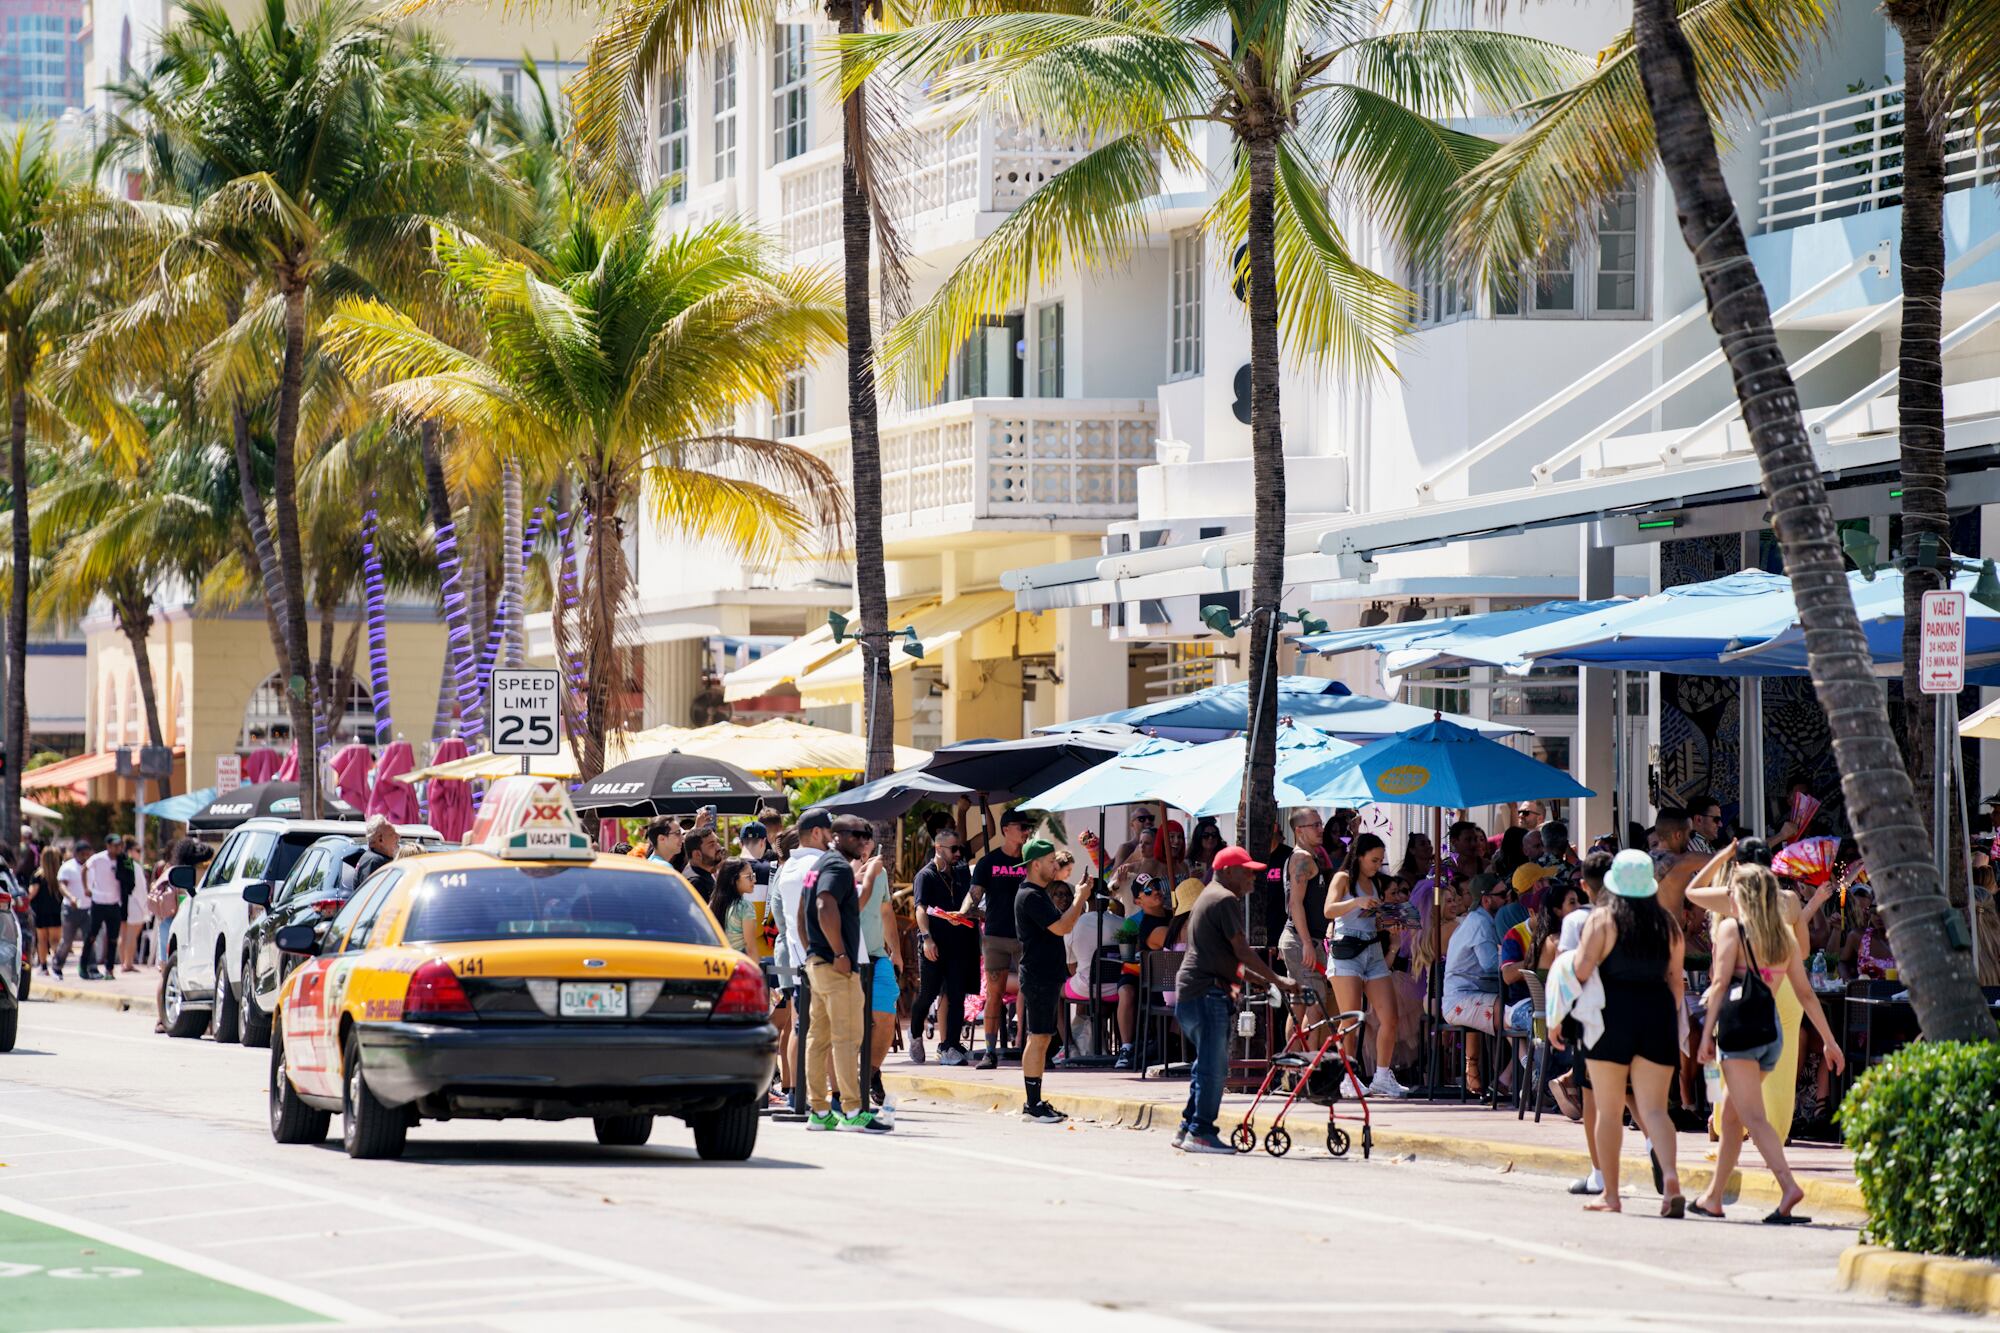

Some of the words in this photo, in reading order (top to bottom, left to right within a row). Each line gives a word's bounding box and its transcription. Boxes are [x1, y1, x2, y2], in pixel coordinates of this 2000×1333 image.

[1932, 601, 1955, 616] VALET
[1926, 622, 1960, 637] PARKING
[1937, 641, 1957, 653] HOURS
[1934, 656, 1945, 667] MIN
[1946, 656, 1959, 667] MAX
[498, 678, 555, 691] SPEED
[504, 697, 548, 709] LIMIT
[498, 715, 553, 746] 25
[590, 782, 645, 795] VALET
[209, 803, 253, 816] VALET
[532, 804, 562, 820] XX
[530, 833, 567, 846] VACANT
[439, 873, 468, 889] 141
[458, 957, 484, 975] 141
[703, 958, 728, 976] 141
